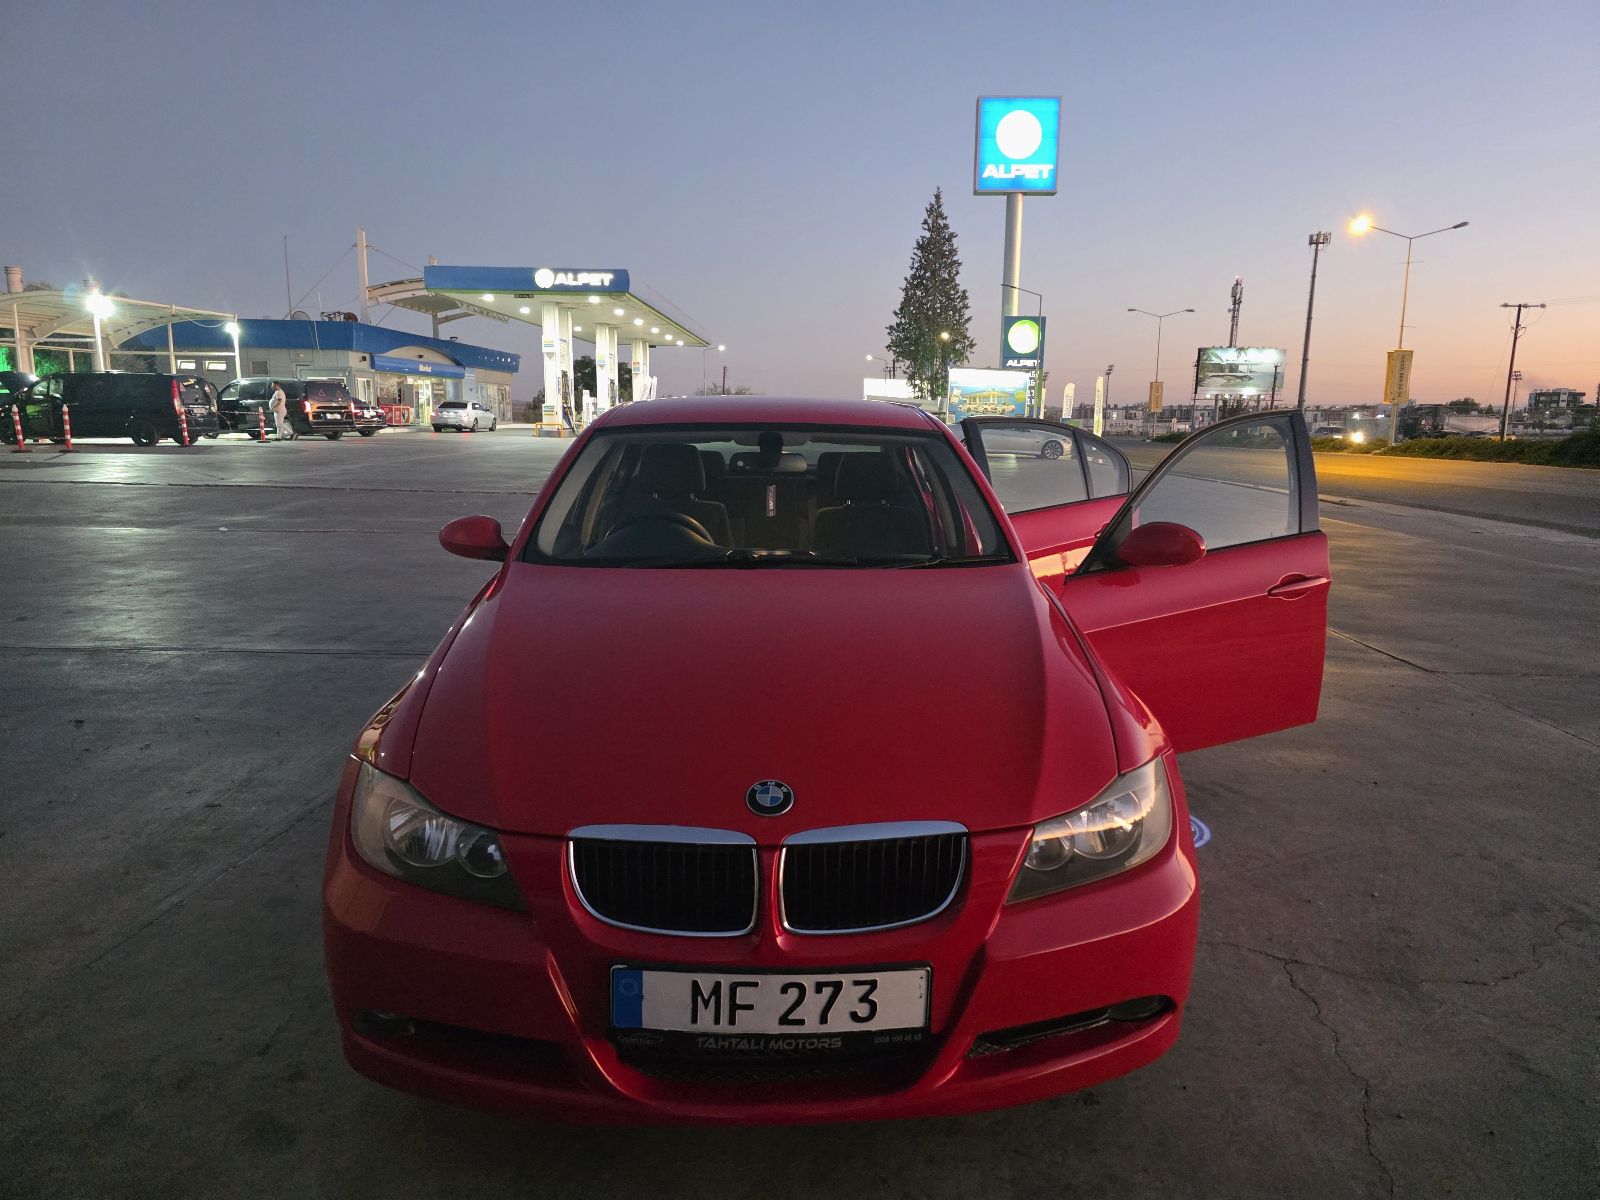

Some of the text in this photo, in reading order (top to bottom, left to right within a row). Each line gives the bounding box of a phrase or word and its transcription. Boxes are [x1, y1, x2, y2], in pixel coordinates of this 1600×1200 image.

[982, 163, 1054, 179] ALPET
[553, 272, 614, 286] ALPET
[1006, 359, 1041, 367] ALPET
[690, 978, 880, 1026] MF 273
[696, 1036, 842, 1051] TAHTALI MOTORS
